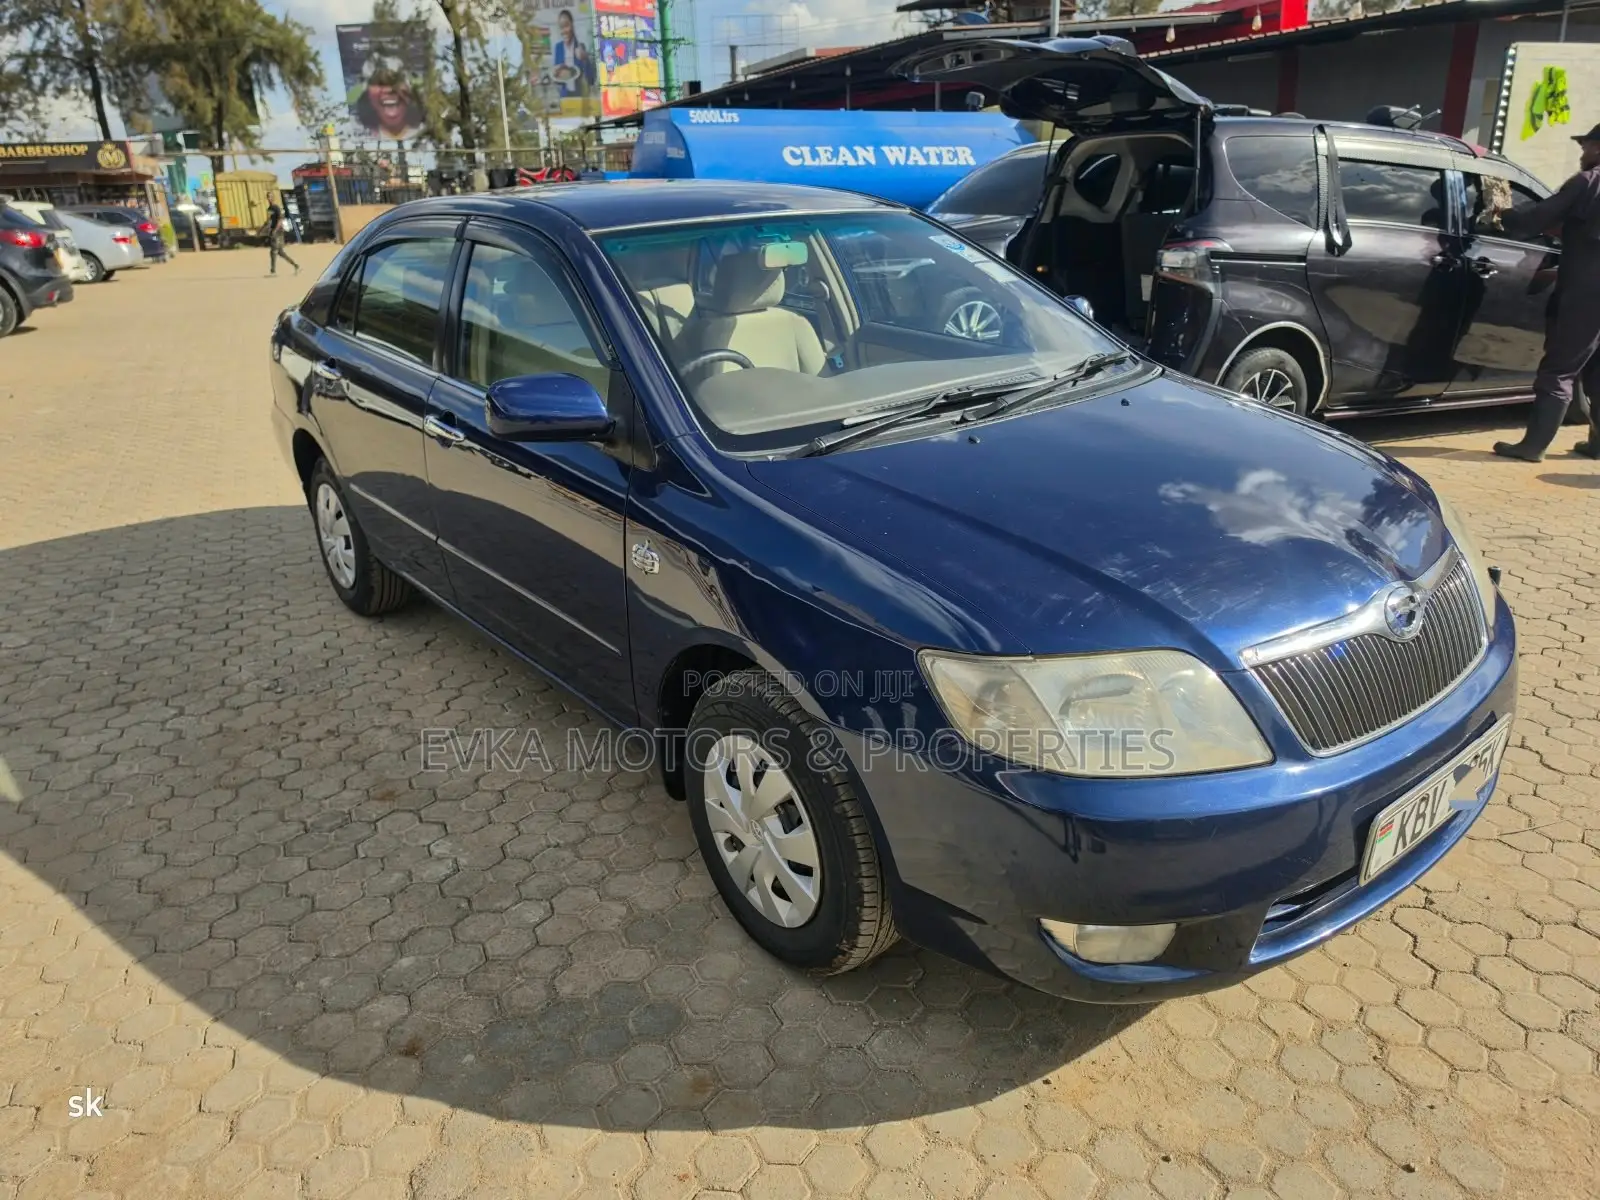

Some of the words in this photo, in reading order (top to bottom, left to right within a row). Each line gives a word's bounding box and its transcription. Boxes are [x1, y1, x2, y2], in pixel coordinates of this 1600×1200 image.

[689, 109, 739, 123] 5000Ltrs
[0, 144, 88, 158] BARBERSHOP
[782, 146, 876, 166] CLEAN
[881, 146, 976, 166] WATER
[1392, 779, 1448, 857] KBV
